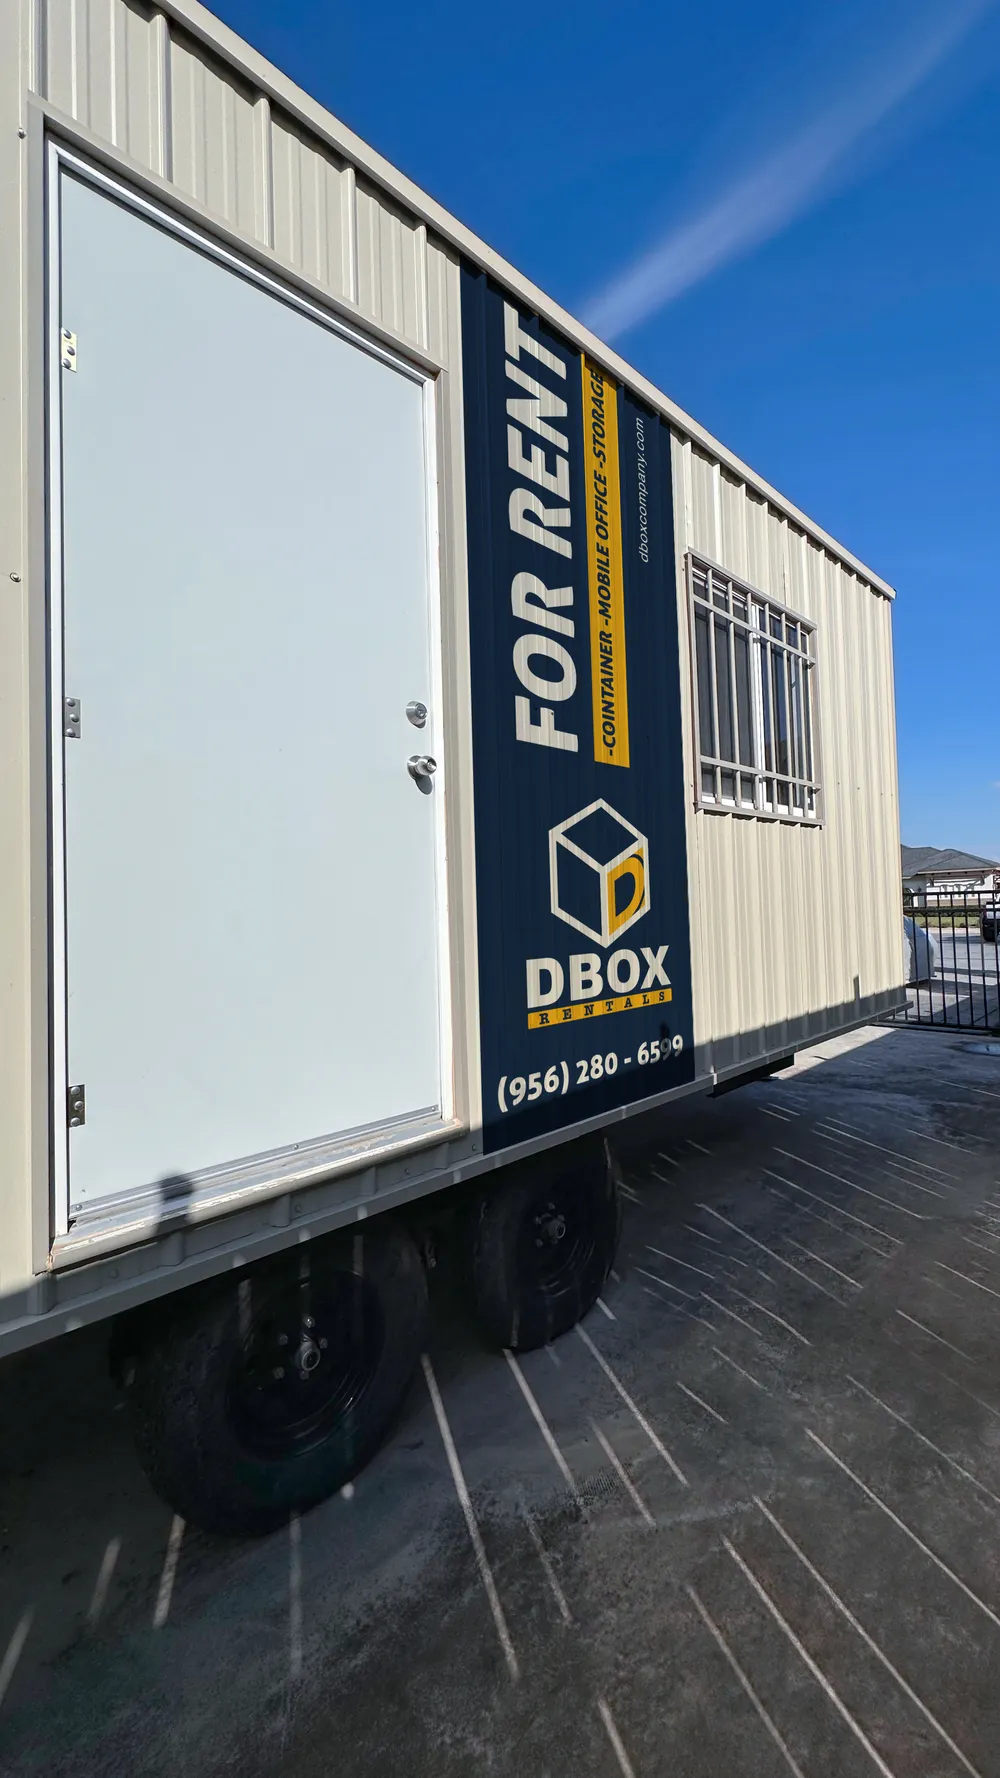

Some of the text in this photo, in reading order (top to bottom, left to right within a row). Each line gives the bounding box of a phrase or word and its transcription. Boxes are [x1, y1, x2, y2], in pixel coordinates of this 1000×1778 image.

[503, 301, 578, 752] FOR RENT
[594, 469, 610, 541] OFFICE
[635, 417, 649, 563] dboxcompany.com
[525, 945, 672, 1009] DBOX
[538, 990, 667, 1026] RENTALS
[497, 1060, 570, 1113] (956)
[576, 1052, 618, 1085] 280
[637, 1034, 684, 1066] 6599
